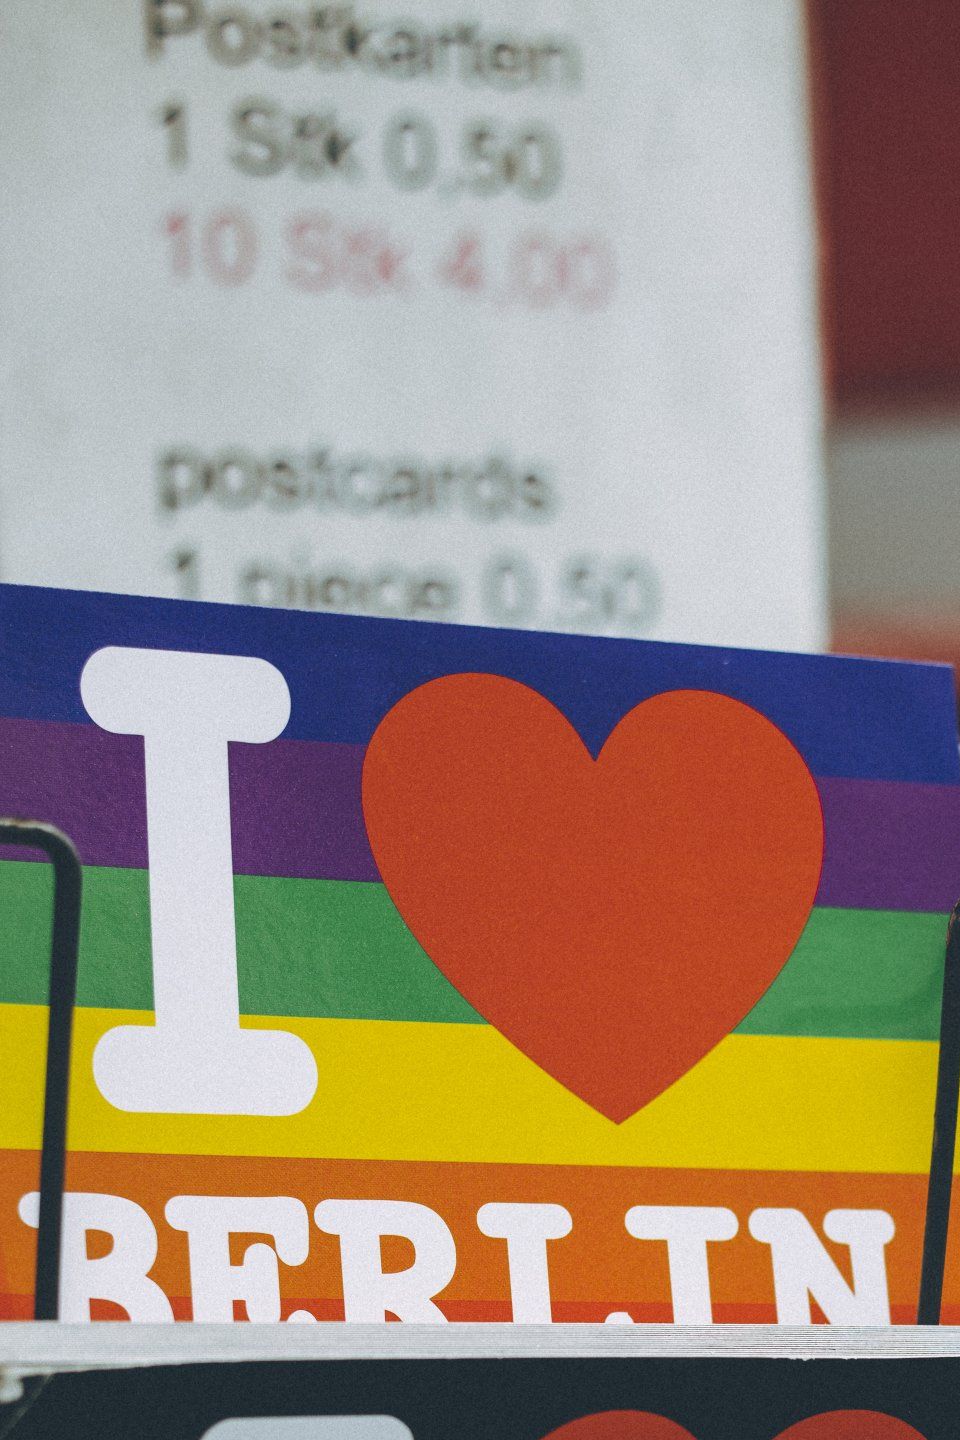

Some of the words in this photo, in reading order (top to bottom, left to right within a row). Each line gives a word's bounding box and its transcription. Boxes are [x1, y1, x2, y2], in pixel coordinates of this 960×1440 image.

[145, 0, 583, 91] Postkarten
[162, 98, 190, 170] 1
[228, 95, 364, 182] Stk
[164, 210, 258, 288] 10
[158, 443, 555, 524] postcards
[80, 646, 318, 1116] I
[18, 1192, 895, 1324] BERLIN
